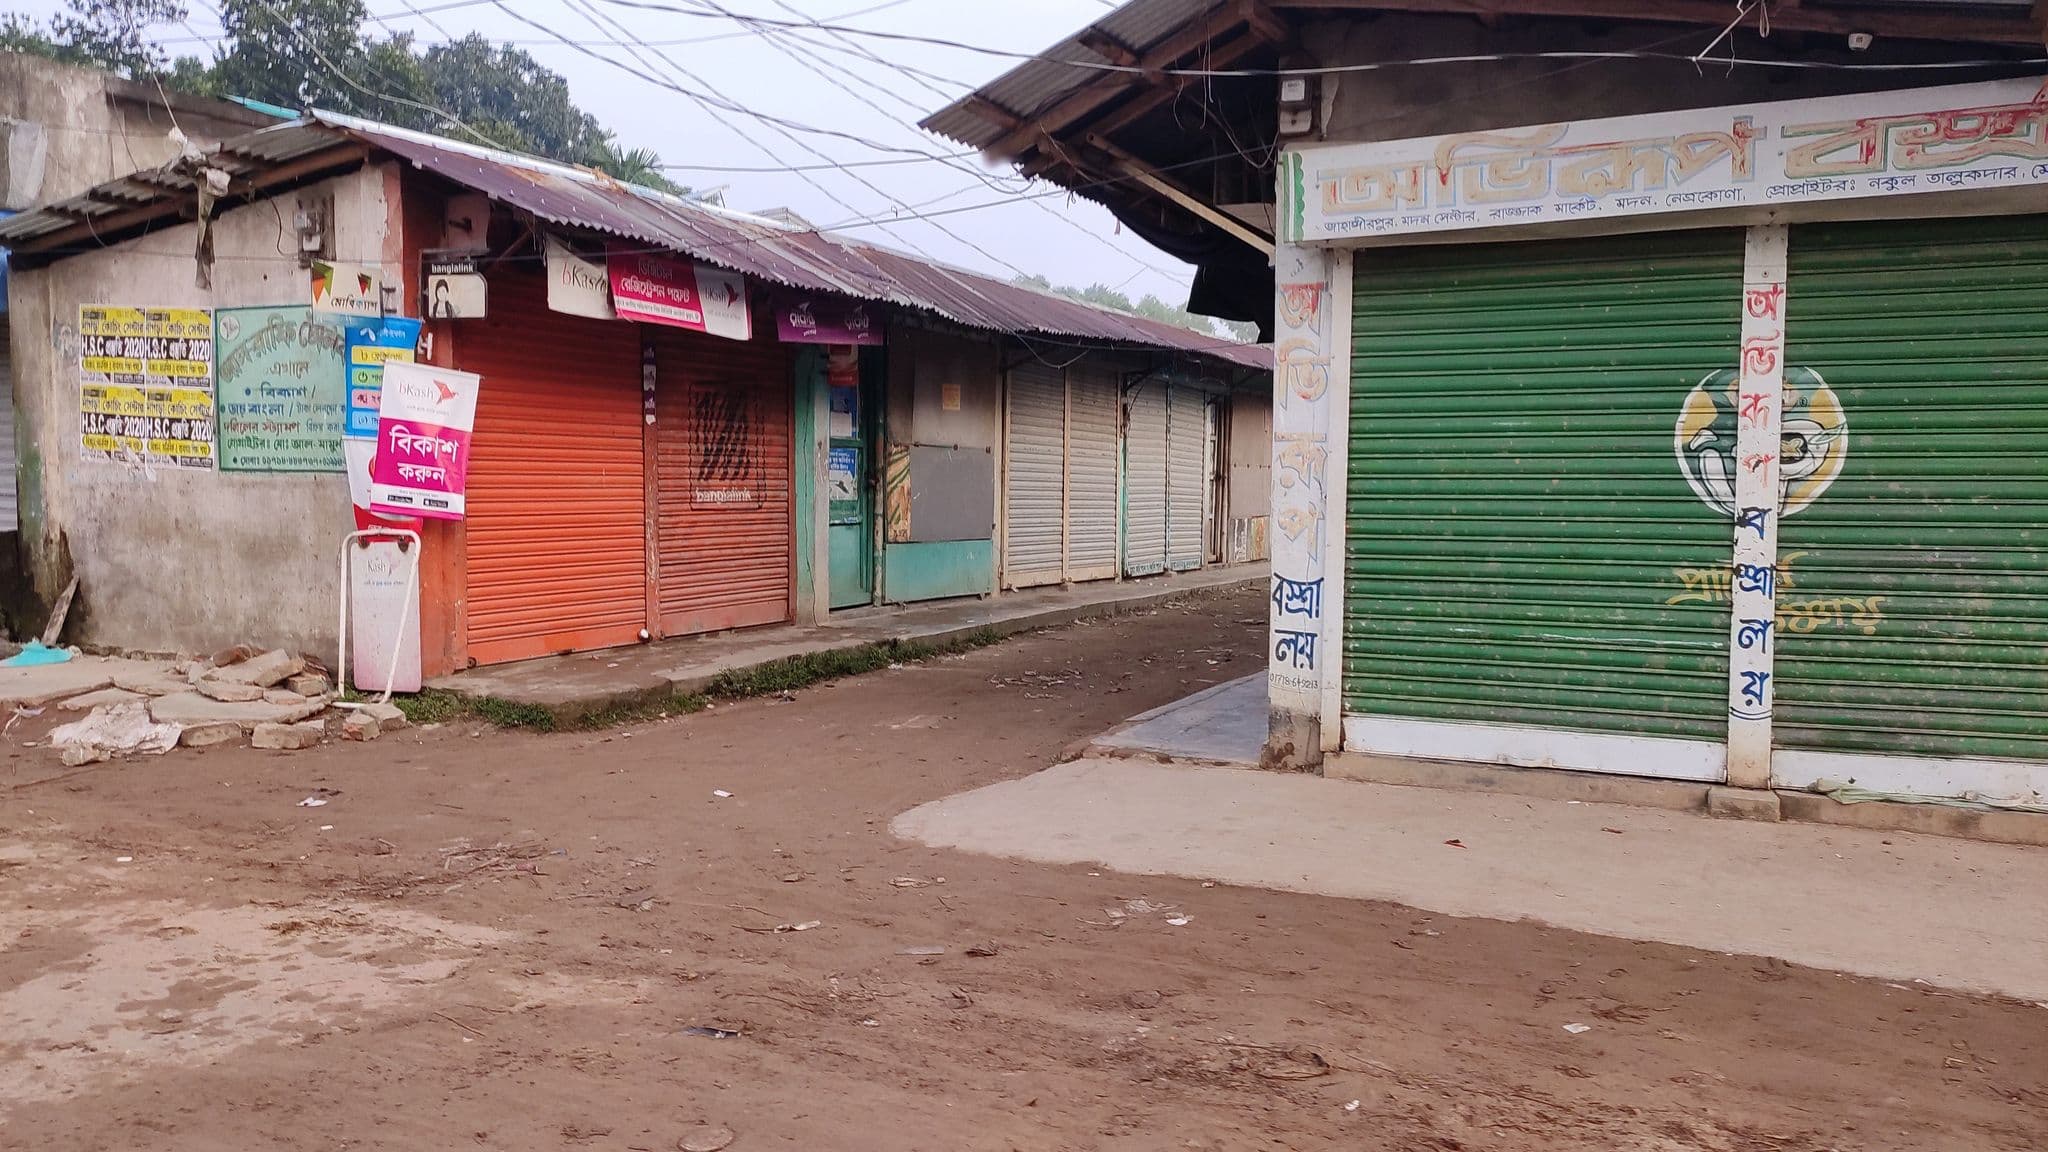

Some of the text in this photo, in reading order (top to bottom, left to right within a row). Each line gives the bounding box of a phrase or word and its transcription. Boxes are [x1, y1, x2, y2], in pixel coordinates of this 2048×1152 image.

[1868, 173, 1916, 191] নকুল
[431, 263, 474, 275] banglalink
[82, 335, 104, 356] H.S.C
[124, 339, 145, 358] 2020
[146, 337, 167, 358] H.S.C
[188, 340, 210, 361] 2020
[260, 381, 307, 399] বিকাশ
[399, 381, 434, 400] bKash
[82, 413, 104, 433] H.S.C
[124, 416, 145, 438] 2020
[147, 418, 169, 438] H.S.C
[190, 420, 212, 441] 2020
[389, 425, 459, 463] বিকাশ
[397, 462, 447, 486] করুন
[695, 487, 751, 505] banglalink
